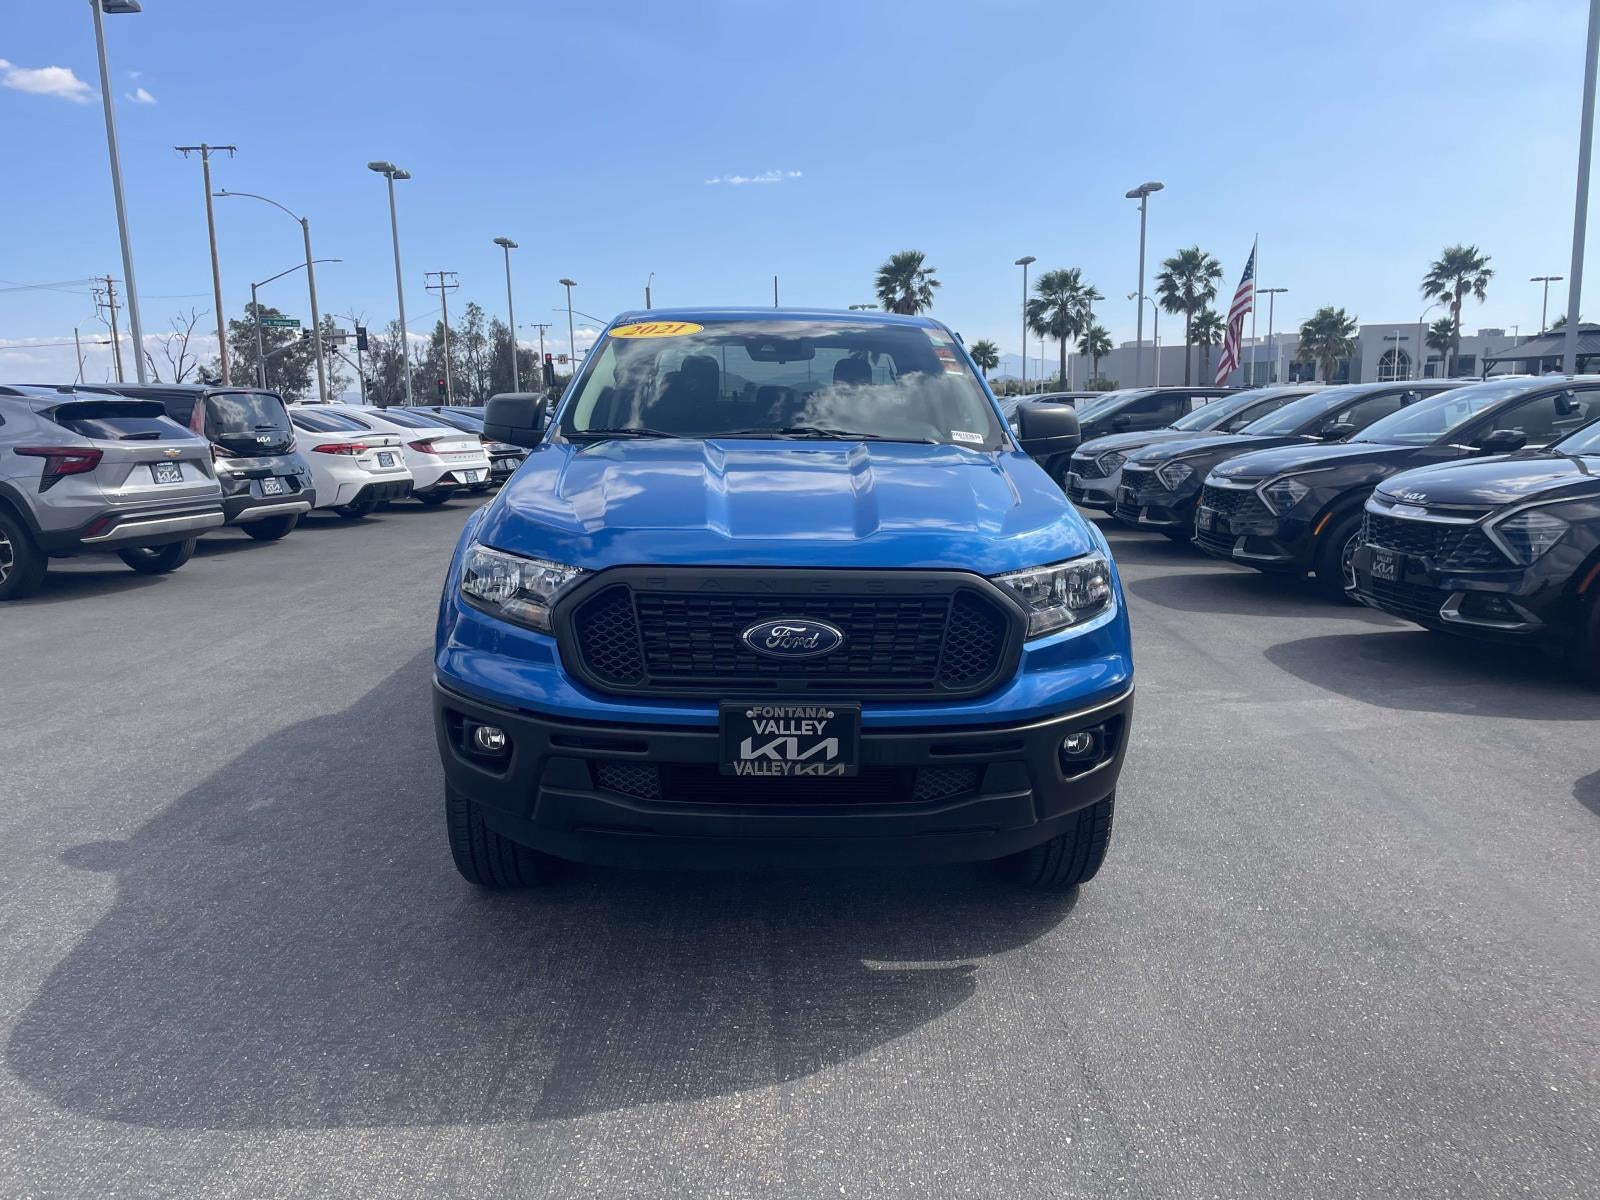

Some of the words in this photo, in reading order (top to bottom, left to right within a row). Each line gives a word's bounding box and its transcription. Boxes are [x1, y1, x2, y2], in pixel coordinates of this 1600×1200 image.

[624, 324, 687, 336] 2021
[1403, 492, 1428, 500] KIA
[1372, 561, 1395, 574] KIA
[645, 576, 940, 592] RANGER
[765, 625, 819, 649] Ford
[752, 706, 828, 718] FONTANA
[752, 719, 828, 735] VALLEY
[740, 736, 839, 760] KIA
[733, 760, 793, 776] VALLEY
[794, 763, 845, 776] KIA
